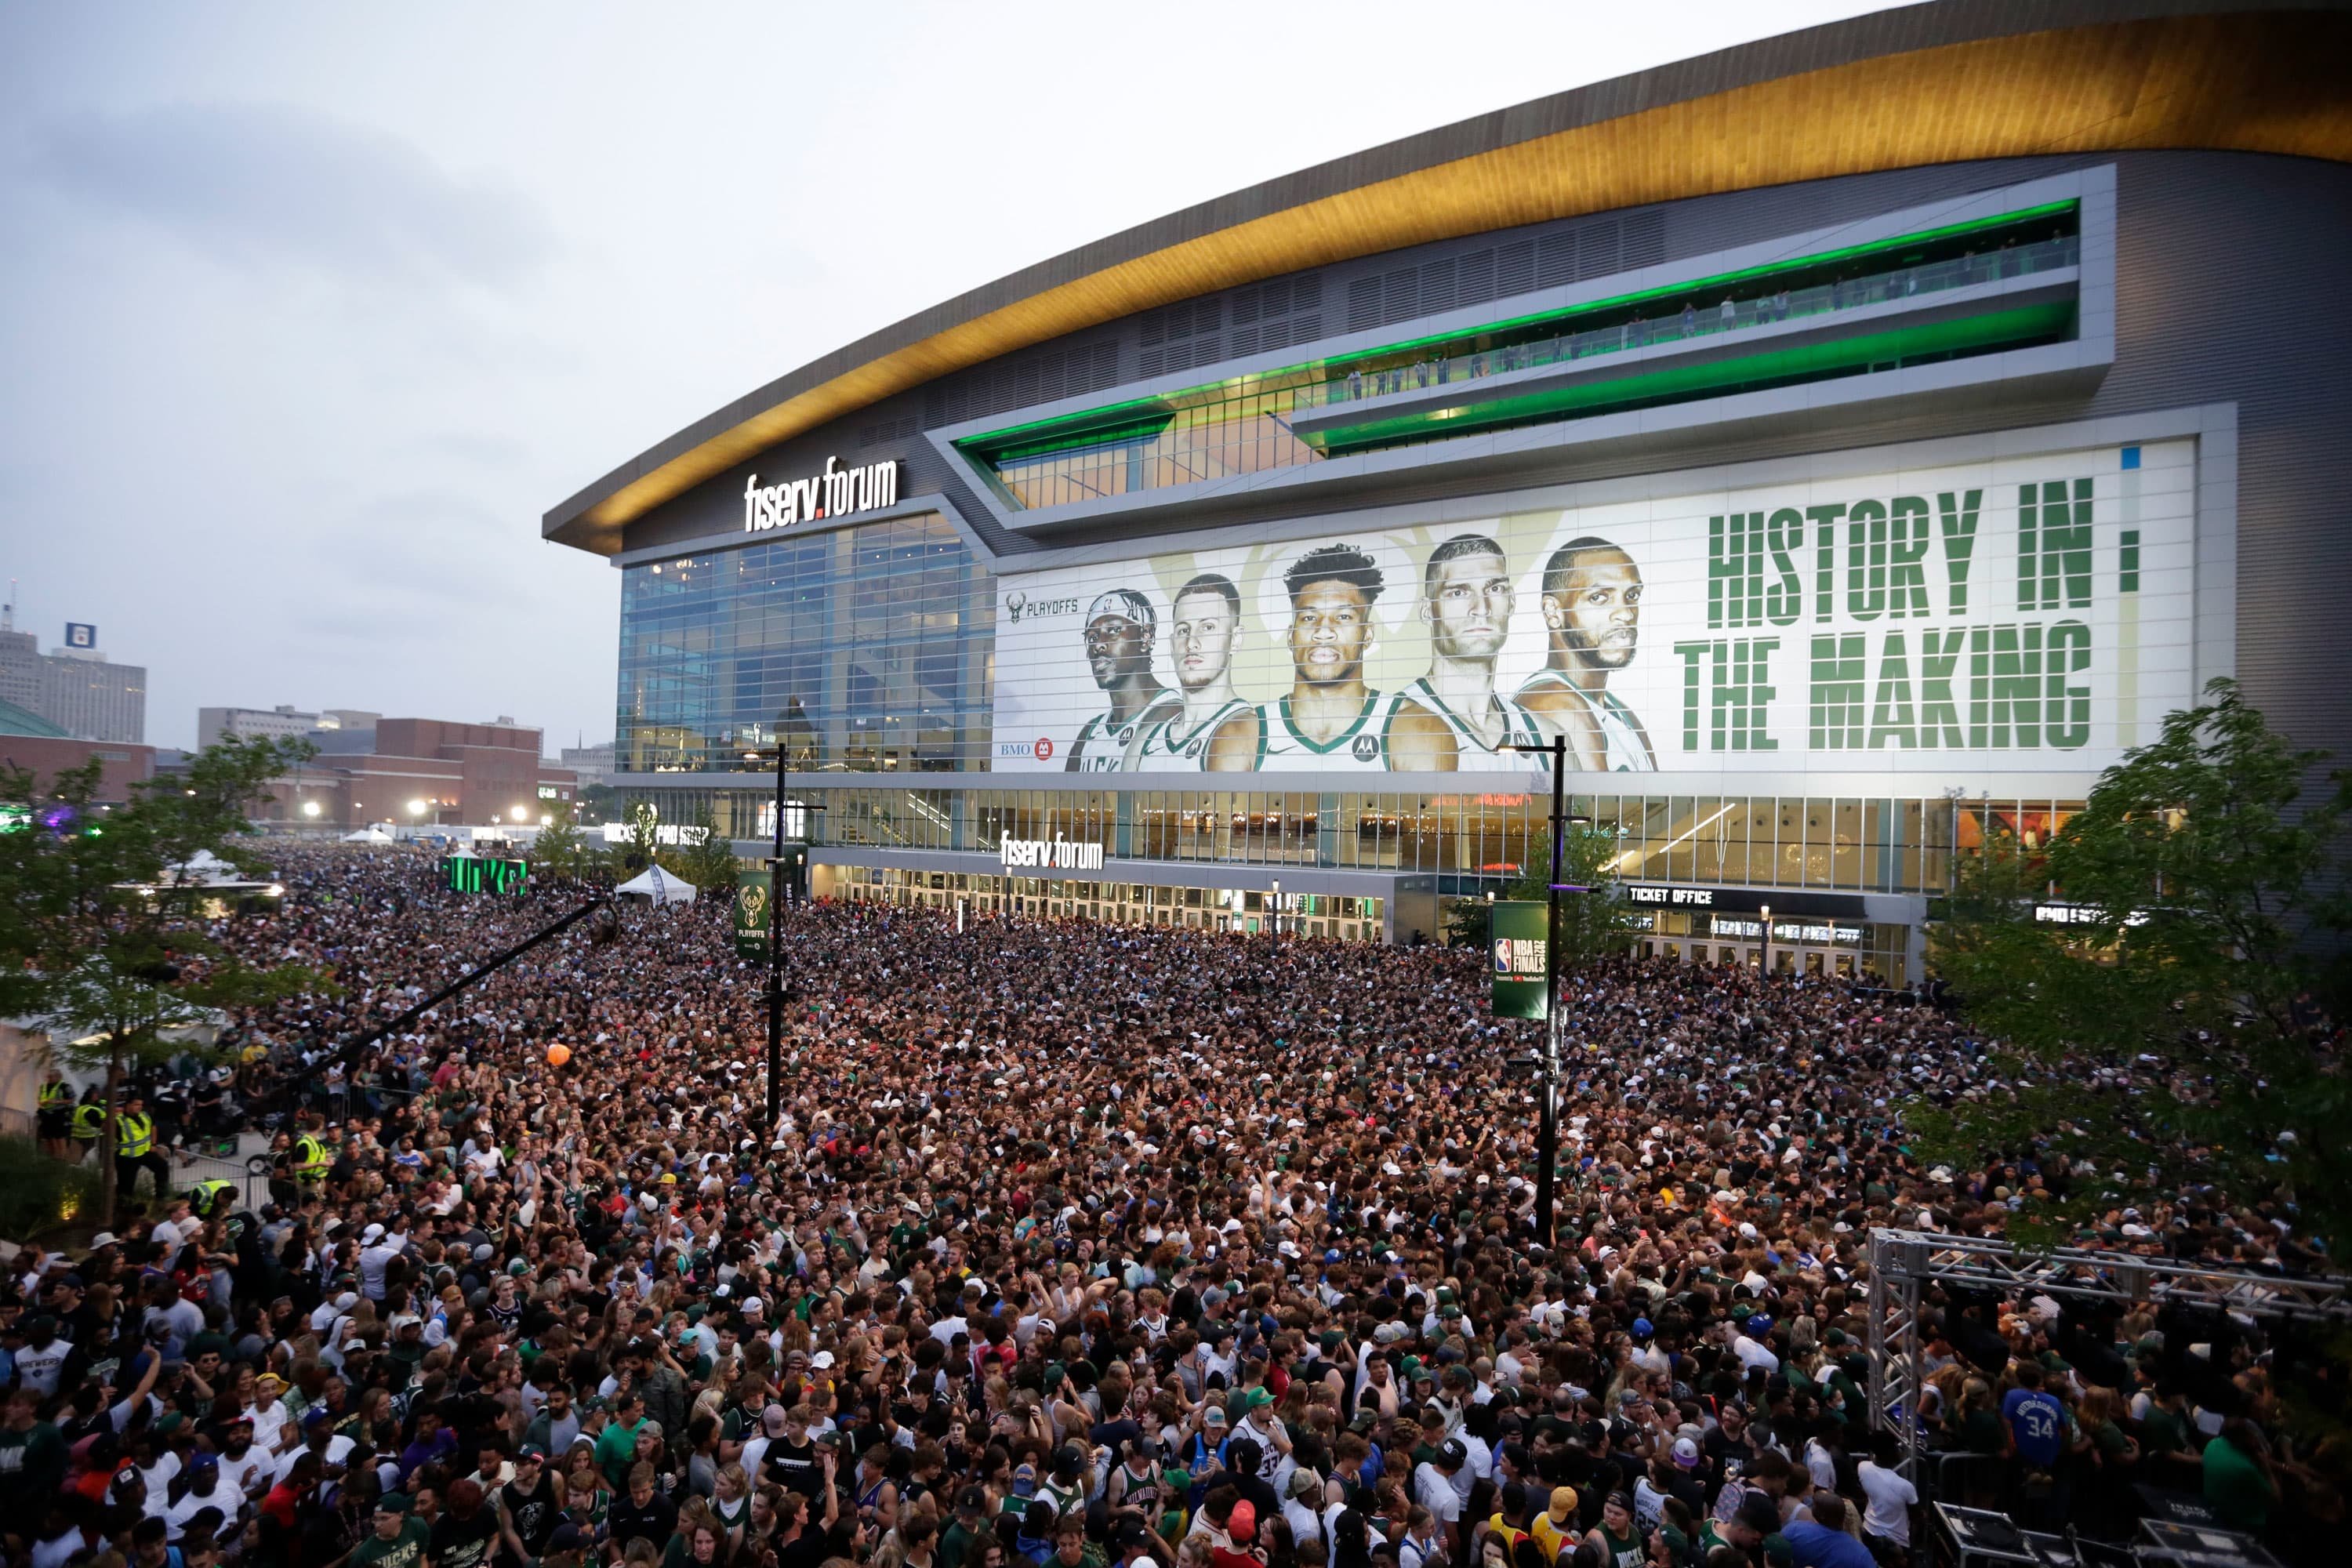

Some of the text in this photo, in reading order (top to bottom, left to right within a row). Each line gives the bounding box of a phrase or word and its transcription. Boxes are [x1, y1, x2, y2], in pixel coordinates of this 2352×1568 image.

[1708, 477, 2093, 630] HISTORY IN
[1027, 598, 1078, 618] PLAYOFFS
[1673, 619, 2091, 752] THE MAKING
[1001, 744, 1031, 756] BMO
[1630, 887, 1712, 905] TICKET OFFICE
[738, 928, 765, 938] PLAYOFFS
[1513, 939, 1534, 956] NBA
[1534, 940, 1546, 956] 2021
[1513, 956, 1546, 973] FINALS
[2025, 1415, 2054, 1440] 34
